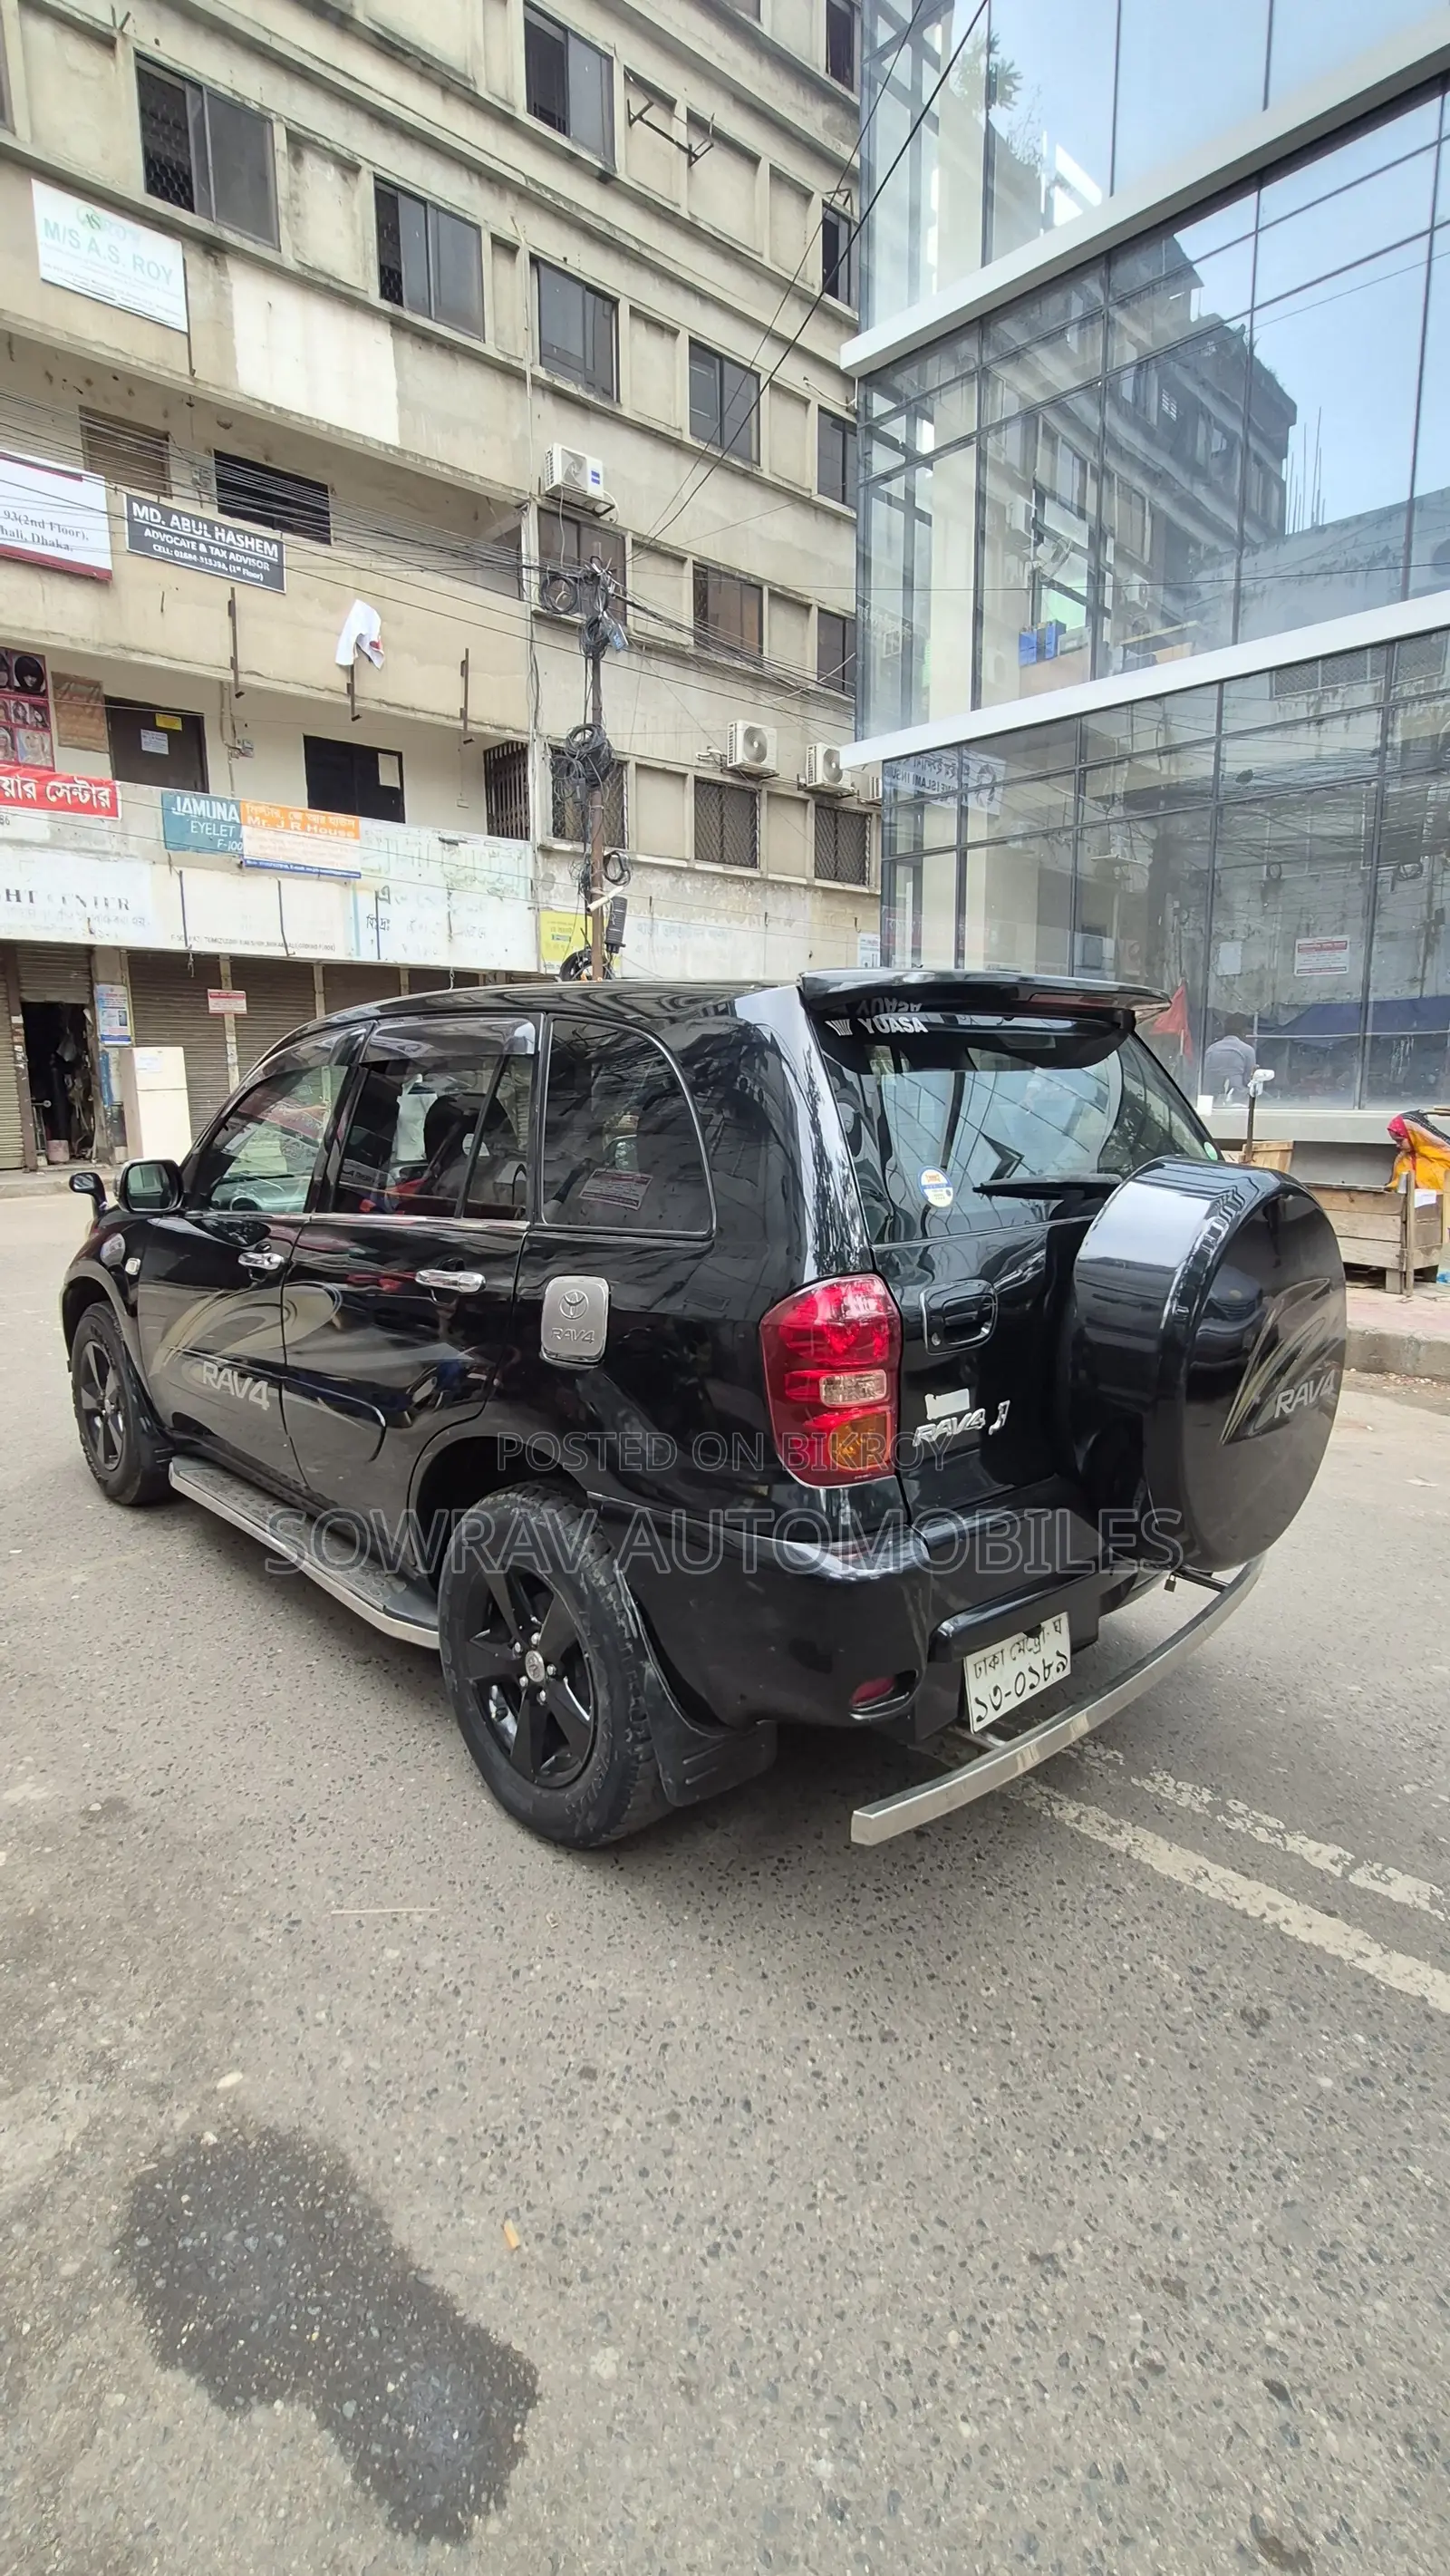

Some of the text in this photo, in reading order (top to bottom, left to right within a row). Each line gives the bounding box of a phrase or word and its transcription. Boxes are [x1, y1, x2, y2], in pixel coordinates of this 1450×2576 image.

[132, 254, 174, 286] ROY
[132, 501, 279, 559] MD. ABUL HASHEM
[144, 528, 198, 552] ADVOCATE
[208, 547, 228, 560] TAX
[228, 551, 271, 573] ADVISOR
[45, 775, 112, 809] সেন্টার
[171, 796, 240, 823] JAMUNA
[190, 820, 236, 838] EYELET
[857, 1016, 929, 1034] YUASA
[551, 1327, 595, 1344] RAV4
[202, 1361, 270, 1411] RAV4
[912, 1408, 986, 1448] RAV4
[973, 1648, 1005, 1679] ঢাকা
[974, 1650, 1068, 1723] ১৩-০১৮৯
